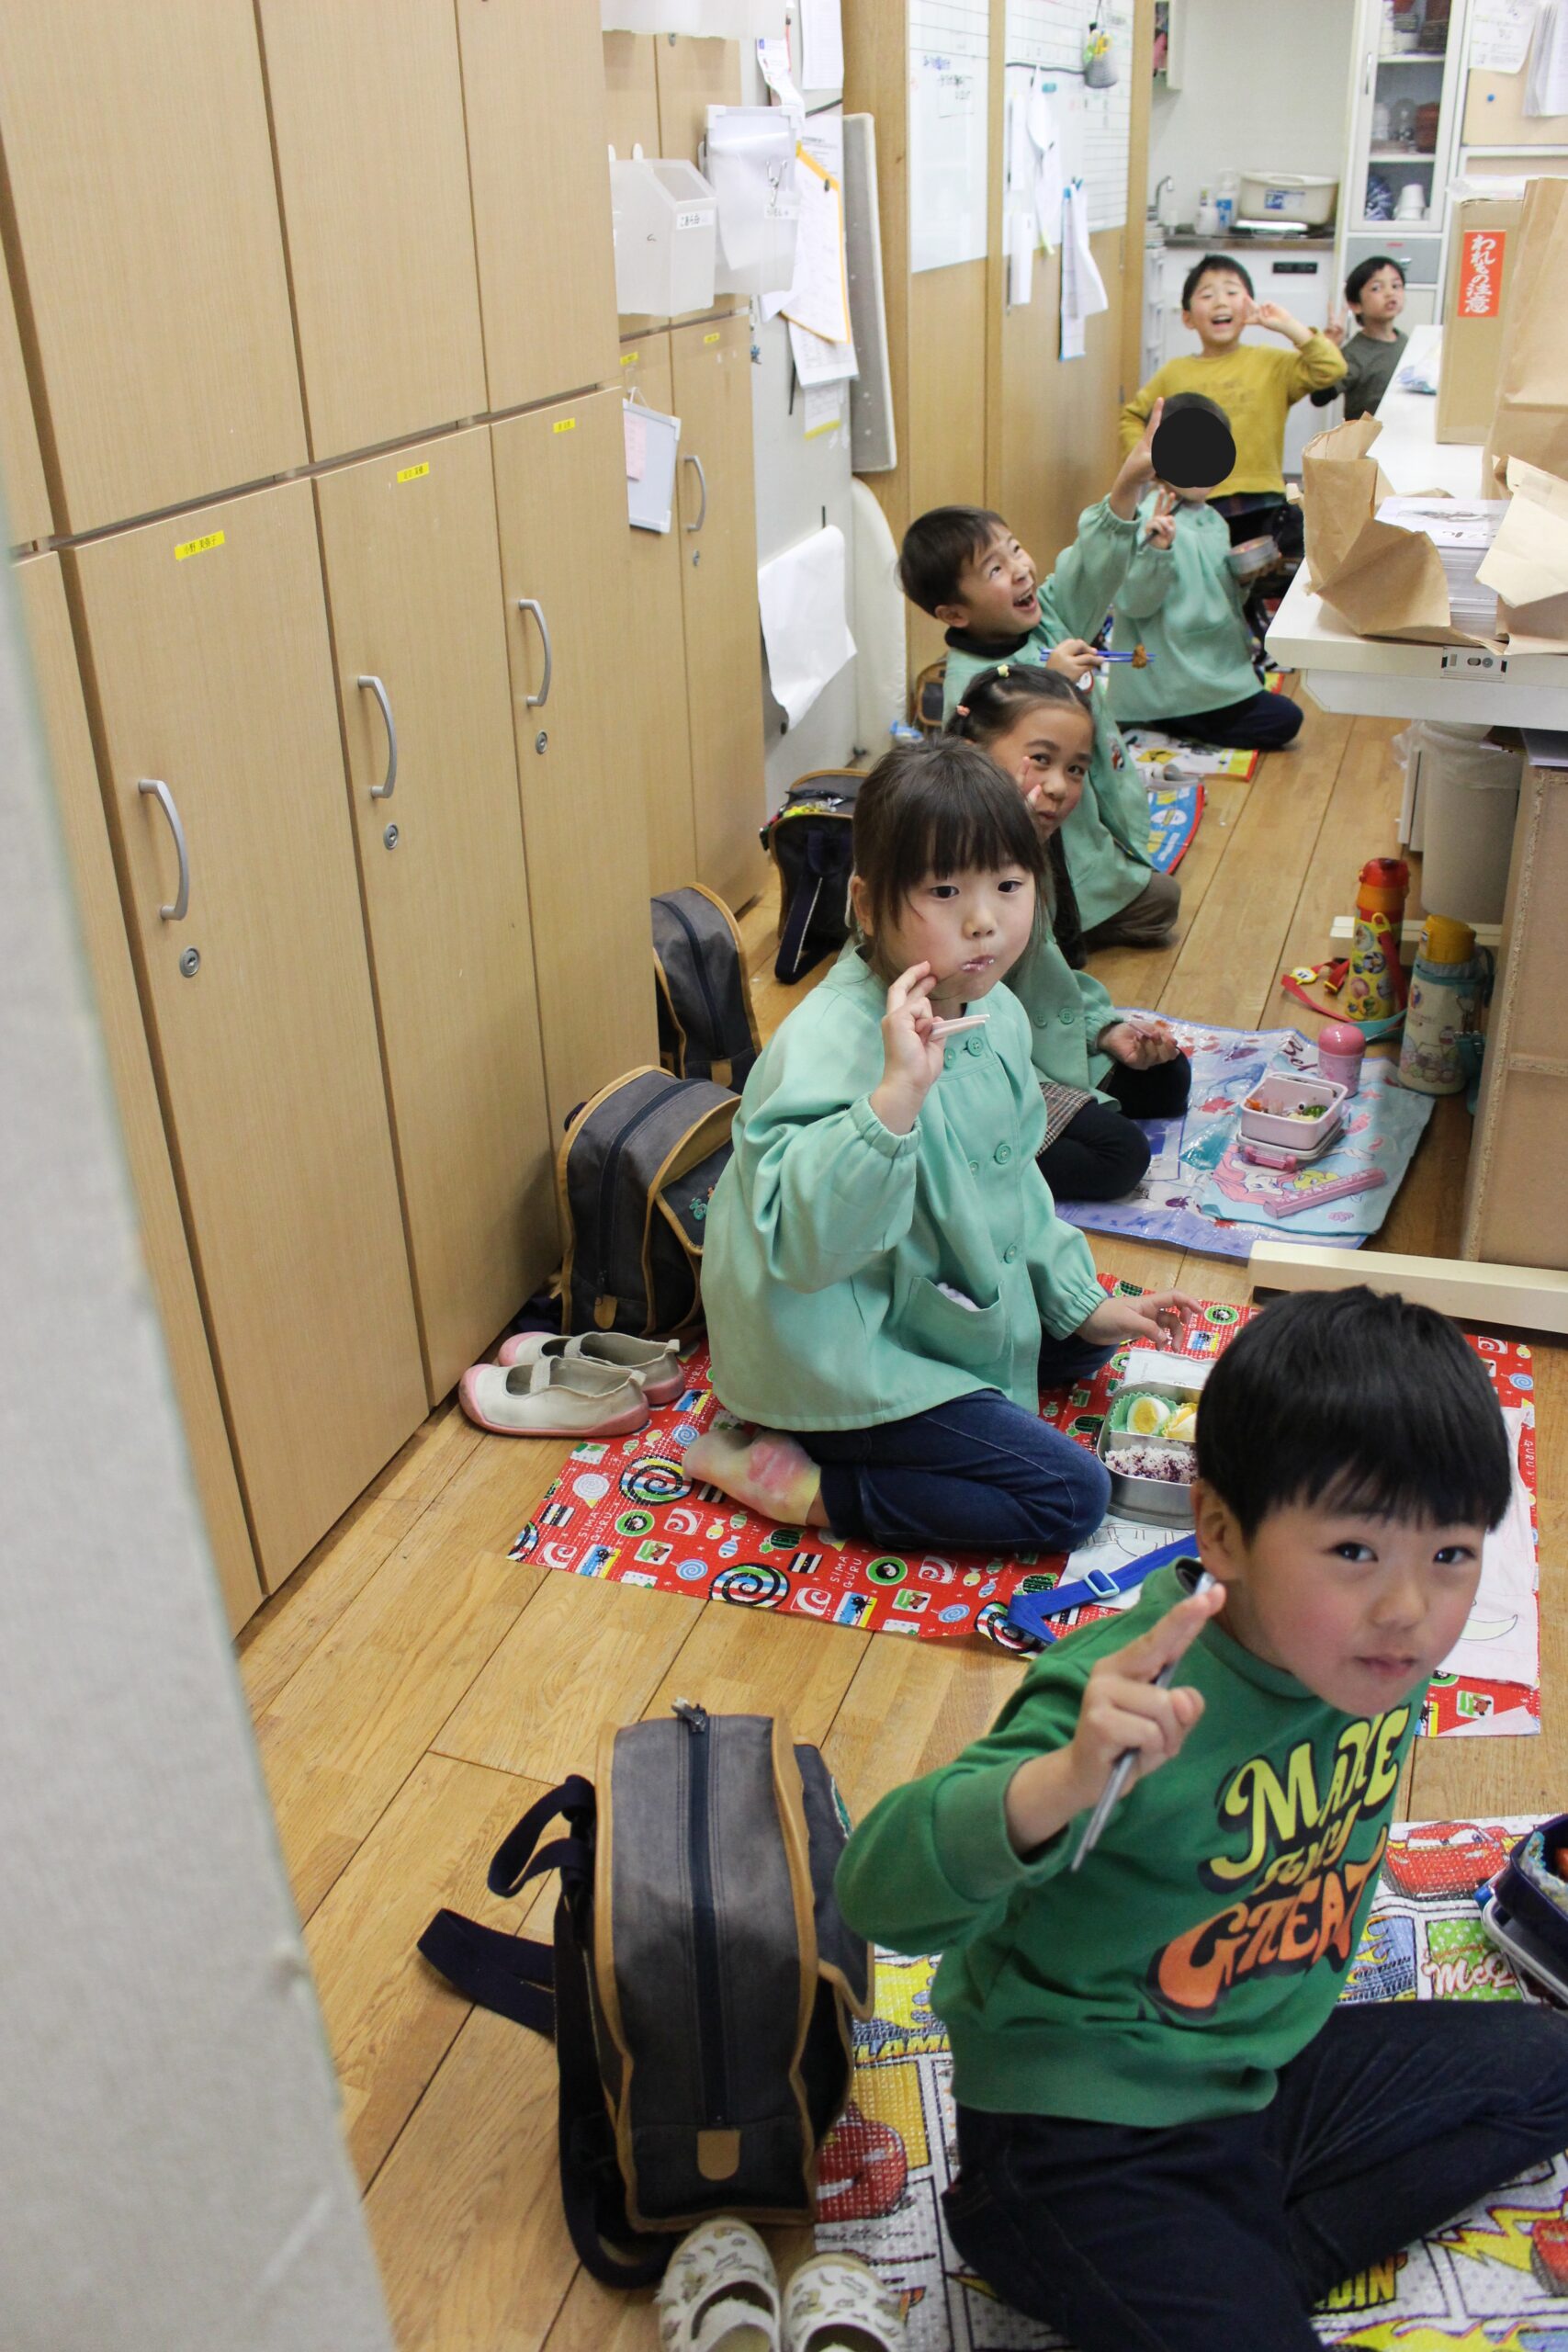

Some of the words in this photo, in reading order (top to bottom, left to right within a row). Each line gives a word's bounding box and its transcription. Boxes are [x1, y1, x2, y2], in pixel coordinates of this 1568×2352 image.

[1464, 234, 1496, 313] われもの注意
[829, 1555, 850, 1583] SIMA
[1209, 1706, 1411, 1881] MAKE
[1157, 1824, 1389, 2010] GREAT
